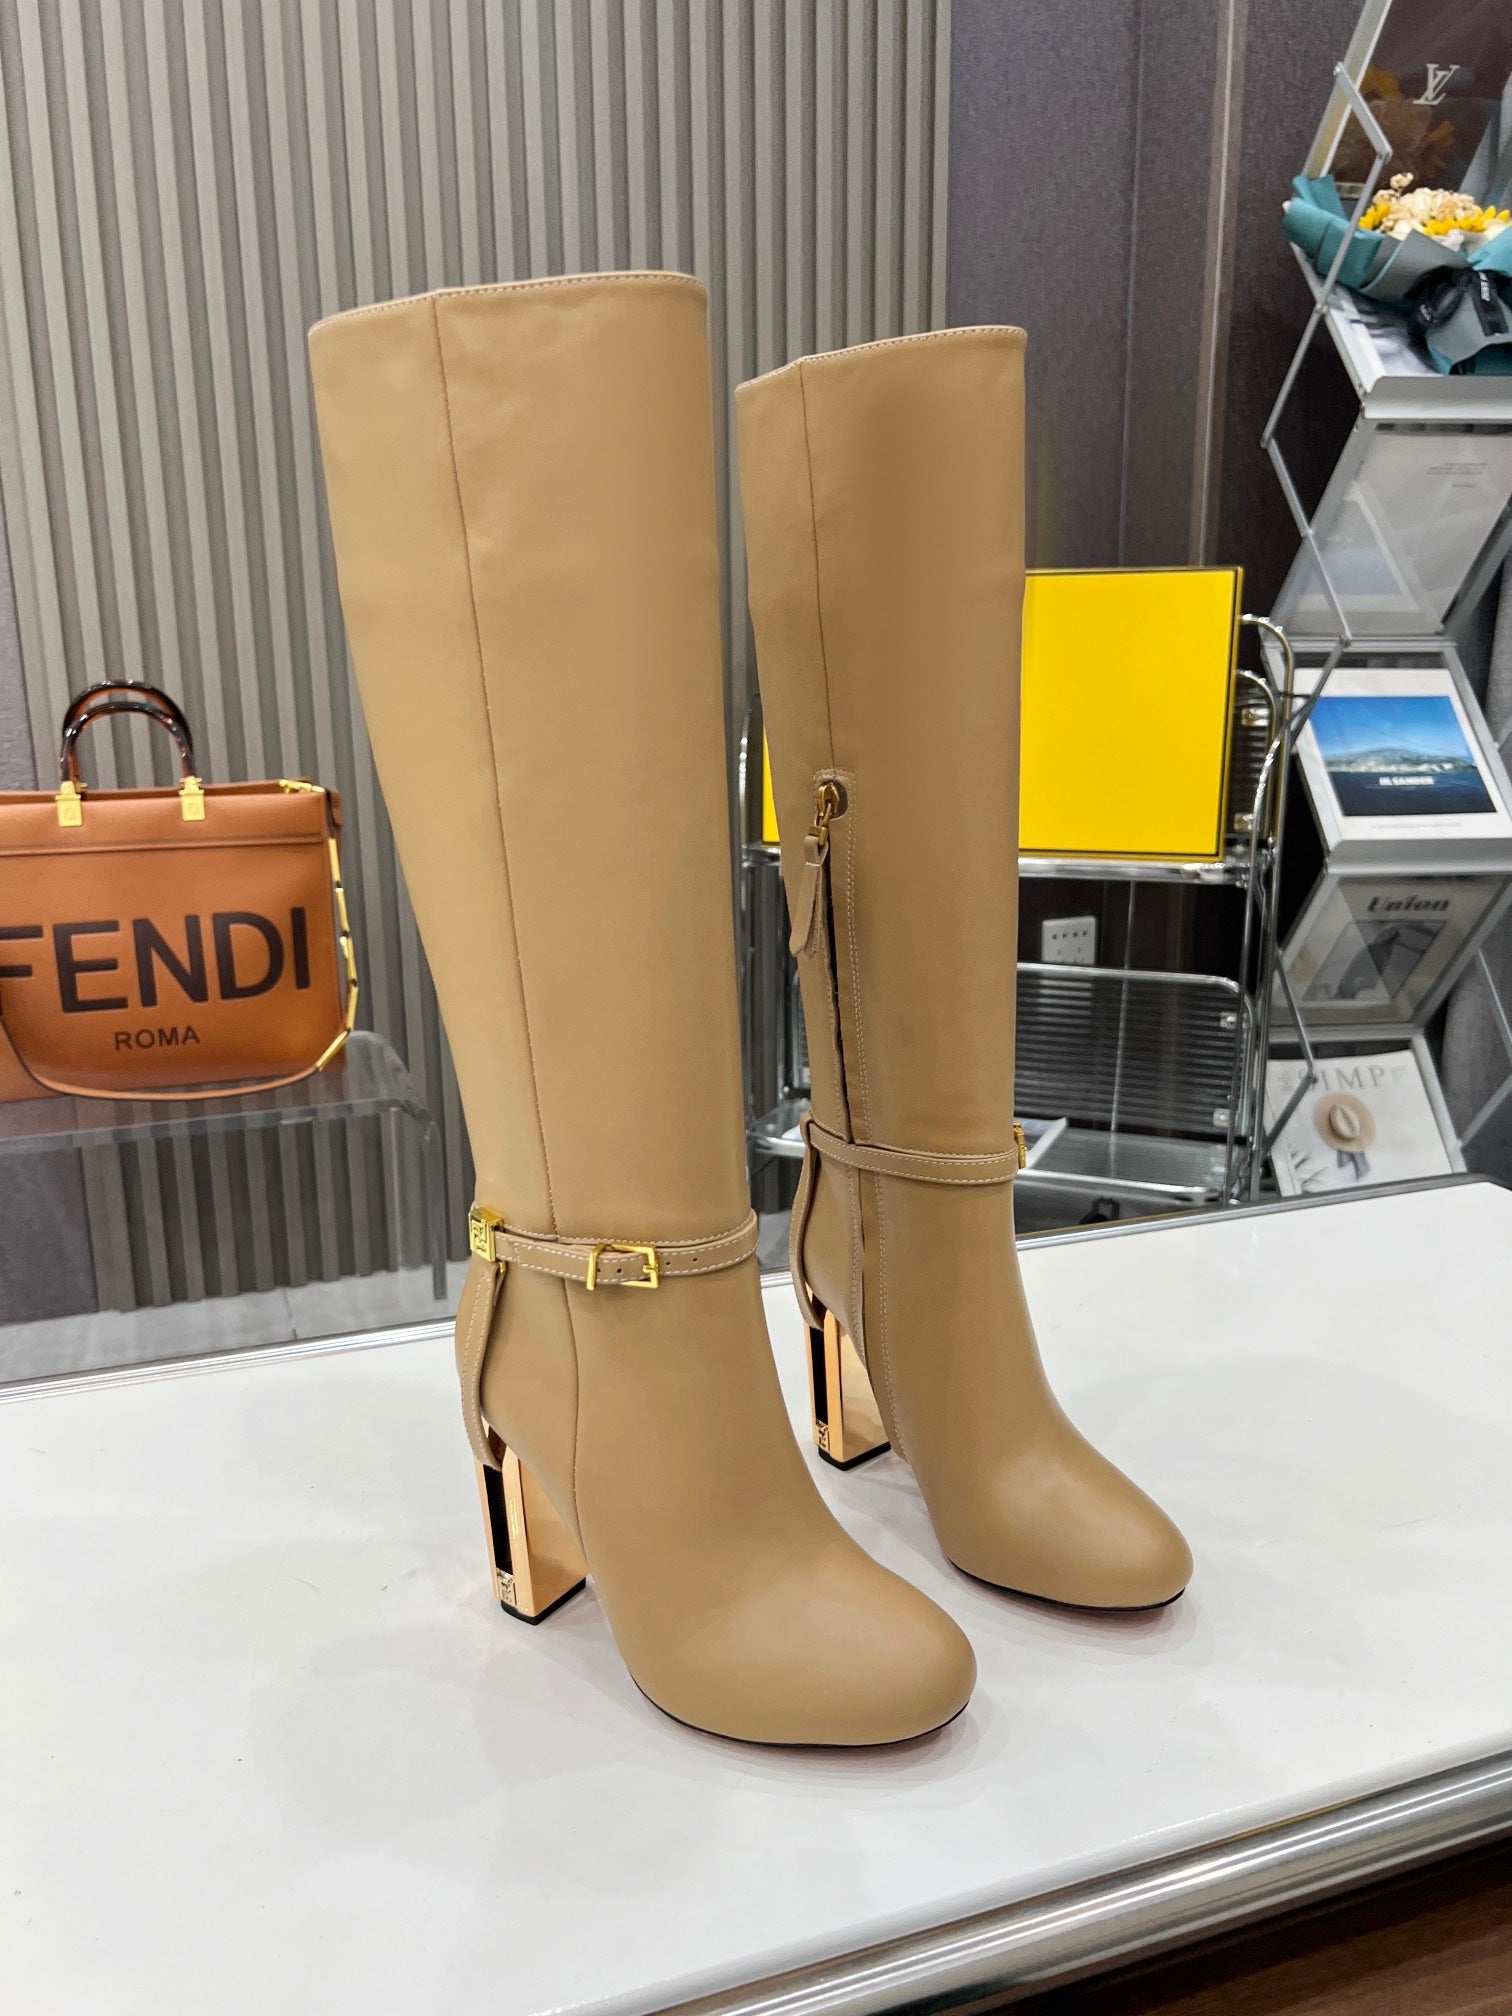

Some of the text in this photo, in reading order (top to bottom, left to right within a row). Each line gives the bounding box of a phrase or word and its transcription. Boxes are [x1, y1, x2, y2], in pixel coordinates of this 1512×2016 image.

[1367, 895, 1449, 912] Union
[0, 906, 310, 1013] FENDI
[114, 1025, 200, 1050] ROMA
